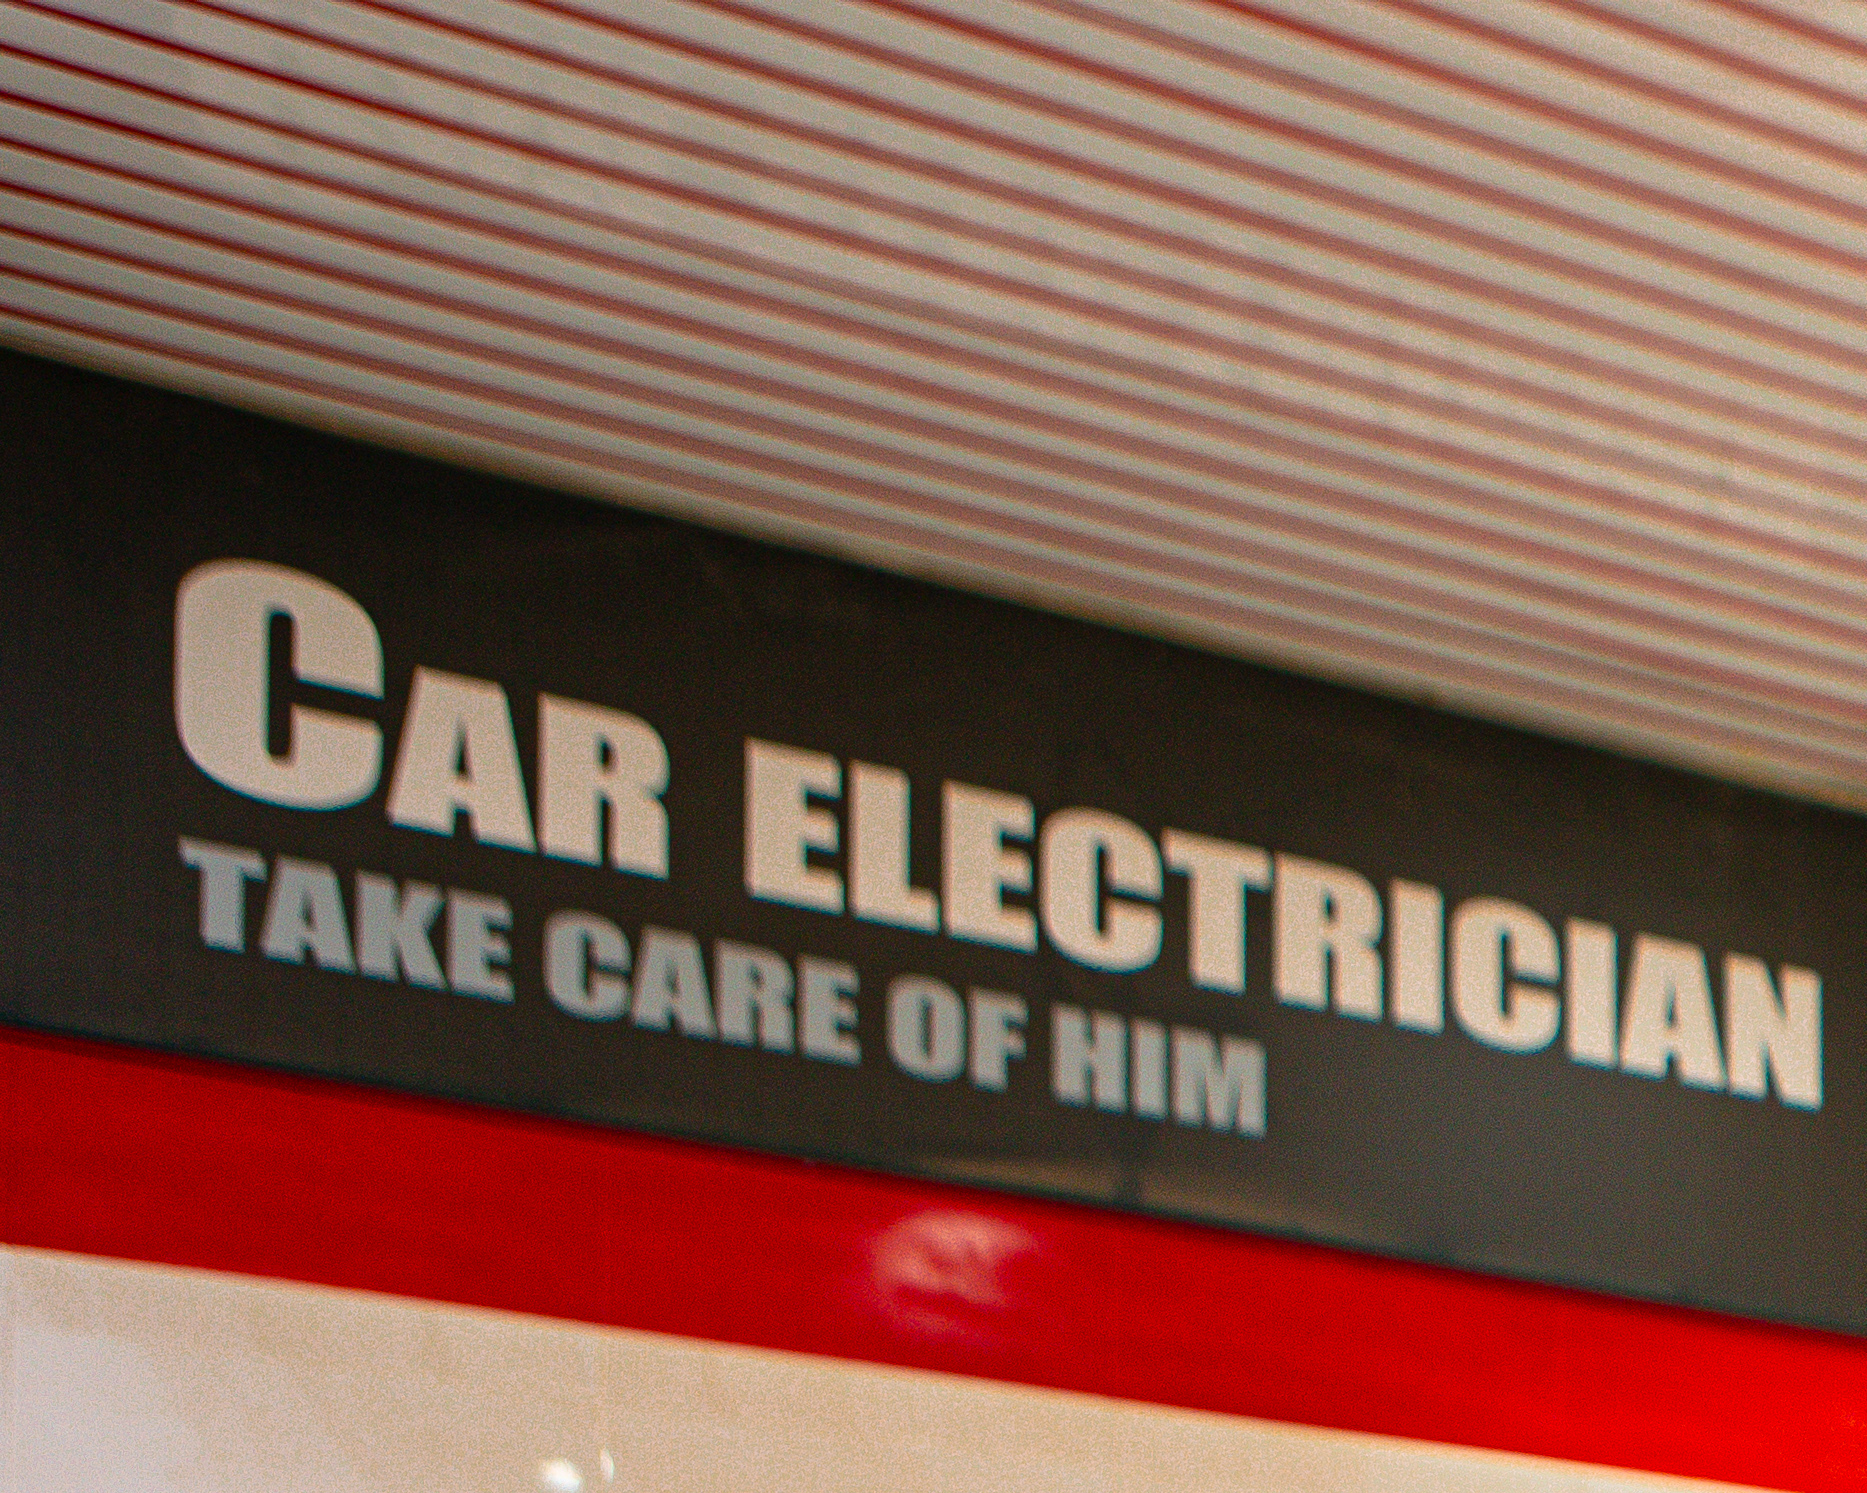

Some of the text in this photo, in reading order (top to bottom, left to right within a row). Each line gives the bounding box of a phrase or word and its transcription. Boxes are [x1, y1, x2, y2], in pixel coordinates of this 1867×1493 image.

[179, 837, 1268, 1137] TAKE CARE OF HIM
[745, 737, 1822, 1109] ELECTRICIAN
